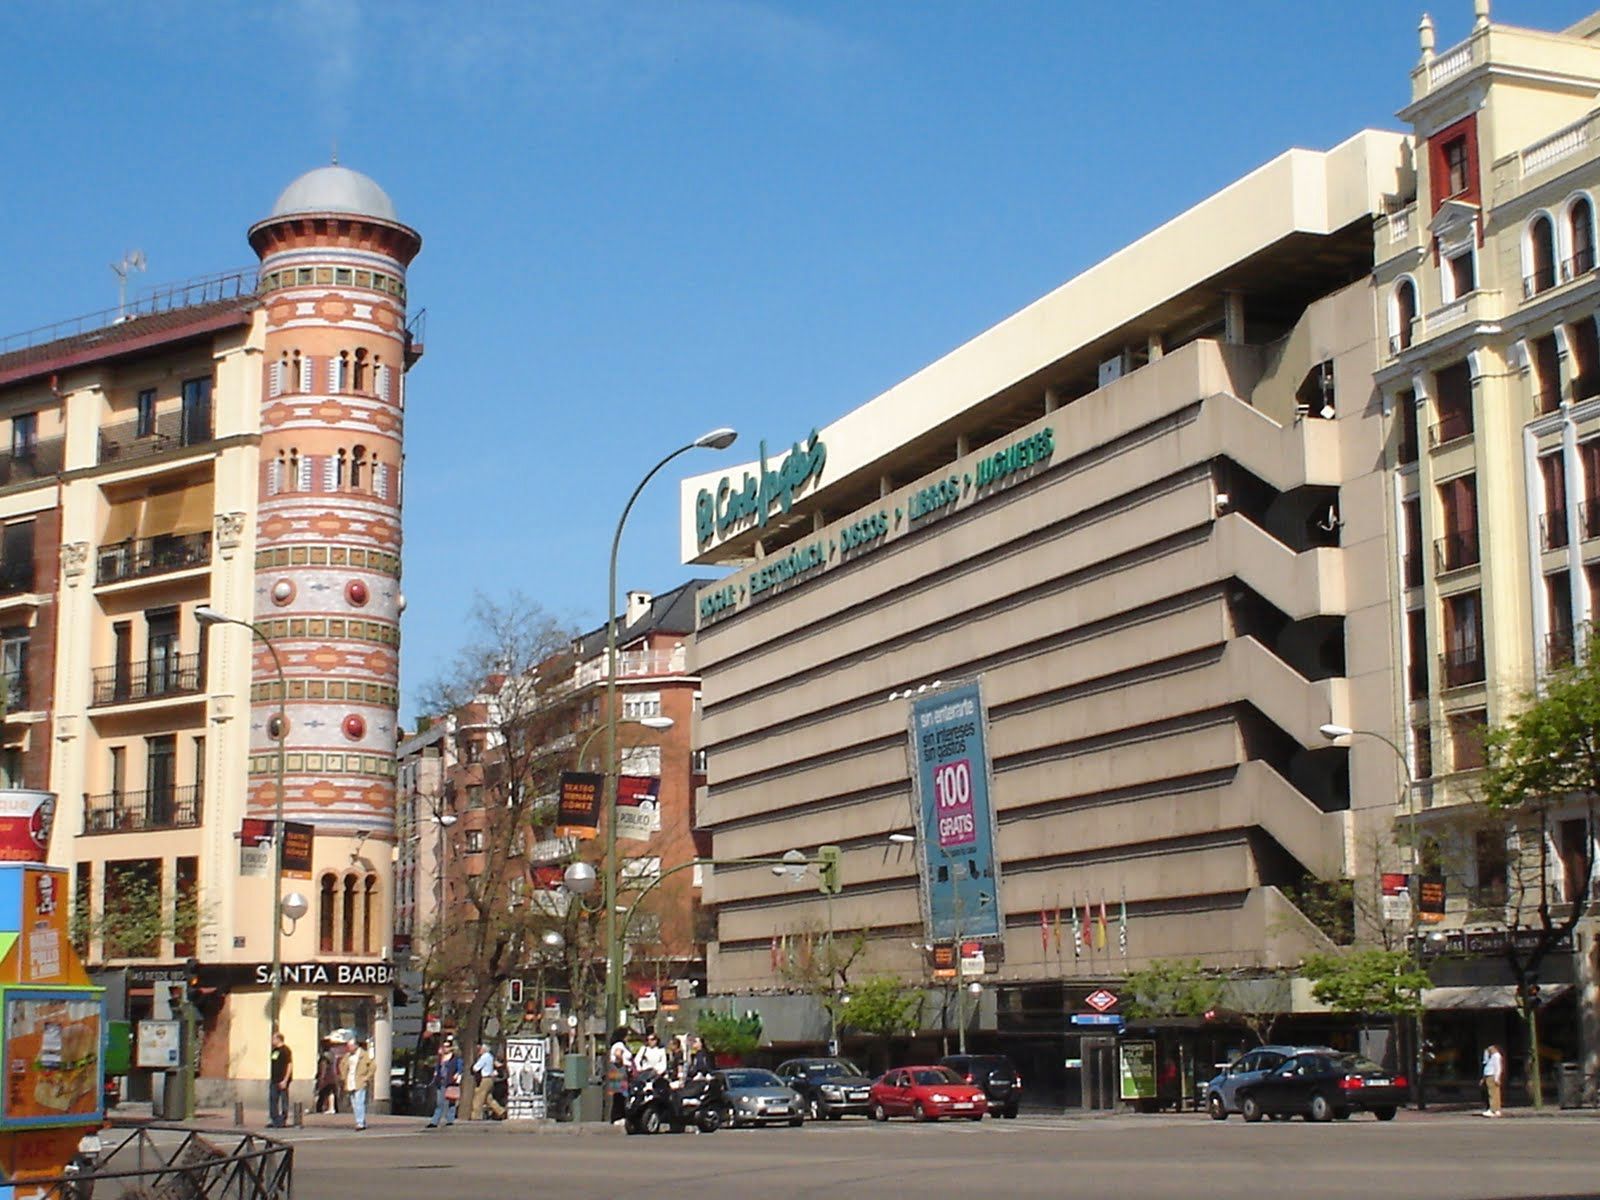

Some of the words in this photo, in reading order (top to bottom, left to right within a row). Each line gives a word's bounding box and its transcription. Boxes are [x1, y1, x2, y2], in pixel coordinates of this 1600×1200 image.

[715, 471, 759, 532] Corte
[840, 510, 889, 553] DISCOS
[908, 475, 960, 522] LIBROS
[975, 426, 1056, 489] JUGUETES
[936, 763, 970, 808] 100
[940, 813, 974, 837] GRATIS
[508, 1044, 540, 1061] TAXI
